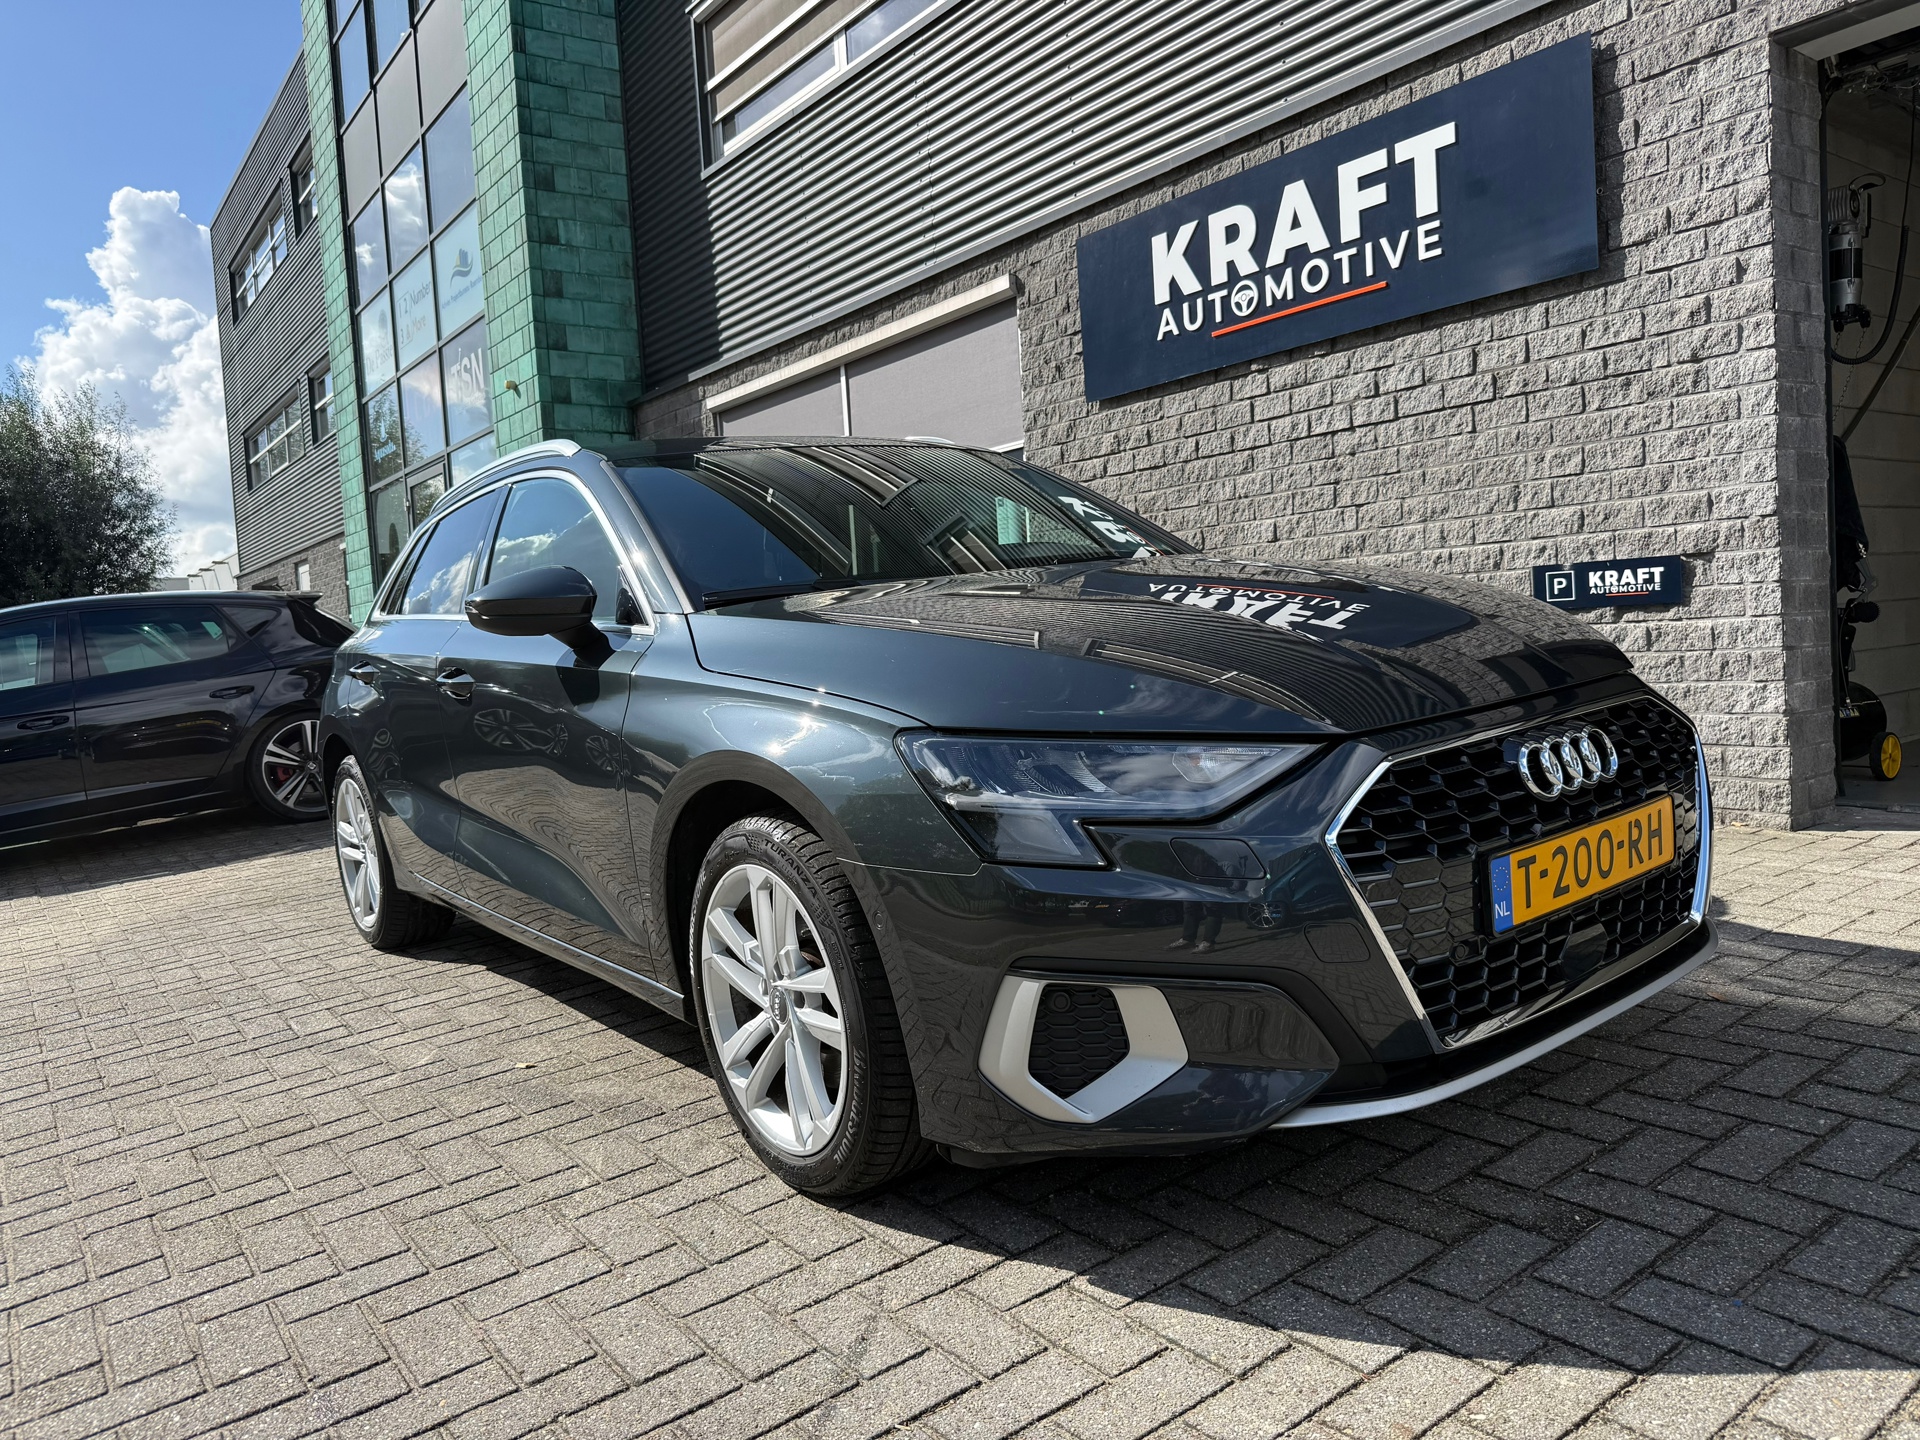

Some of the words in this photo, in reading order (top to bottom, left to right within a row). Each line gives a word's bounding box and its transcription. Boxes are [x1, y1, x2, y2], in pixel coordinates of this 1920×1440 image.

[1151, 121, 1456, 305] KRAFT
[1156, 219, 1443, 341] AUTOMOTIVE
[410, 281, 431, 309] Number
[1553, 577, 1567, 595] P
[1588, 566, 1664, 588] KRAFT
[1589, 582, 1662, 595] AUTOMOTIVE
[763, 838, 818, 898] TURANZA
[1517, 807, 1663, 909] T-200-RH
[1494, 901, 1510, 920] NL
